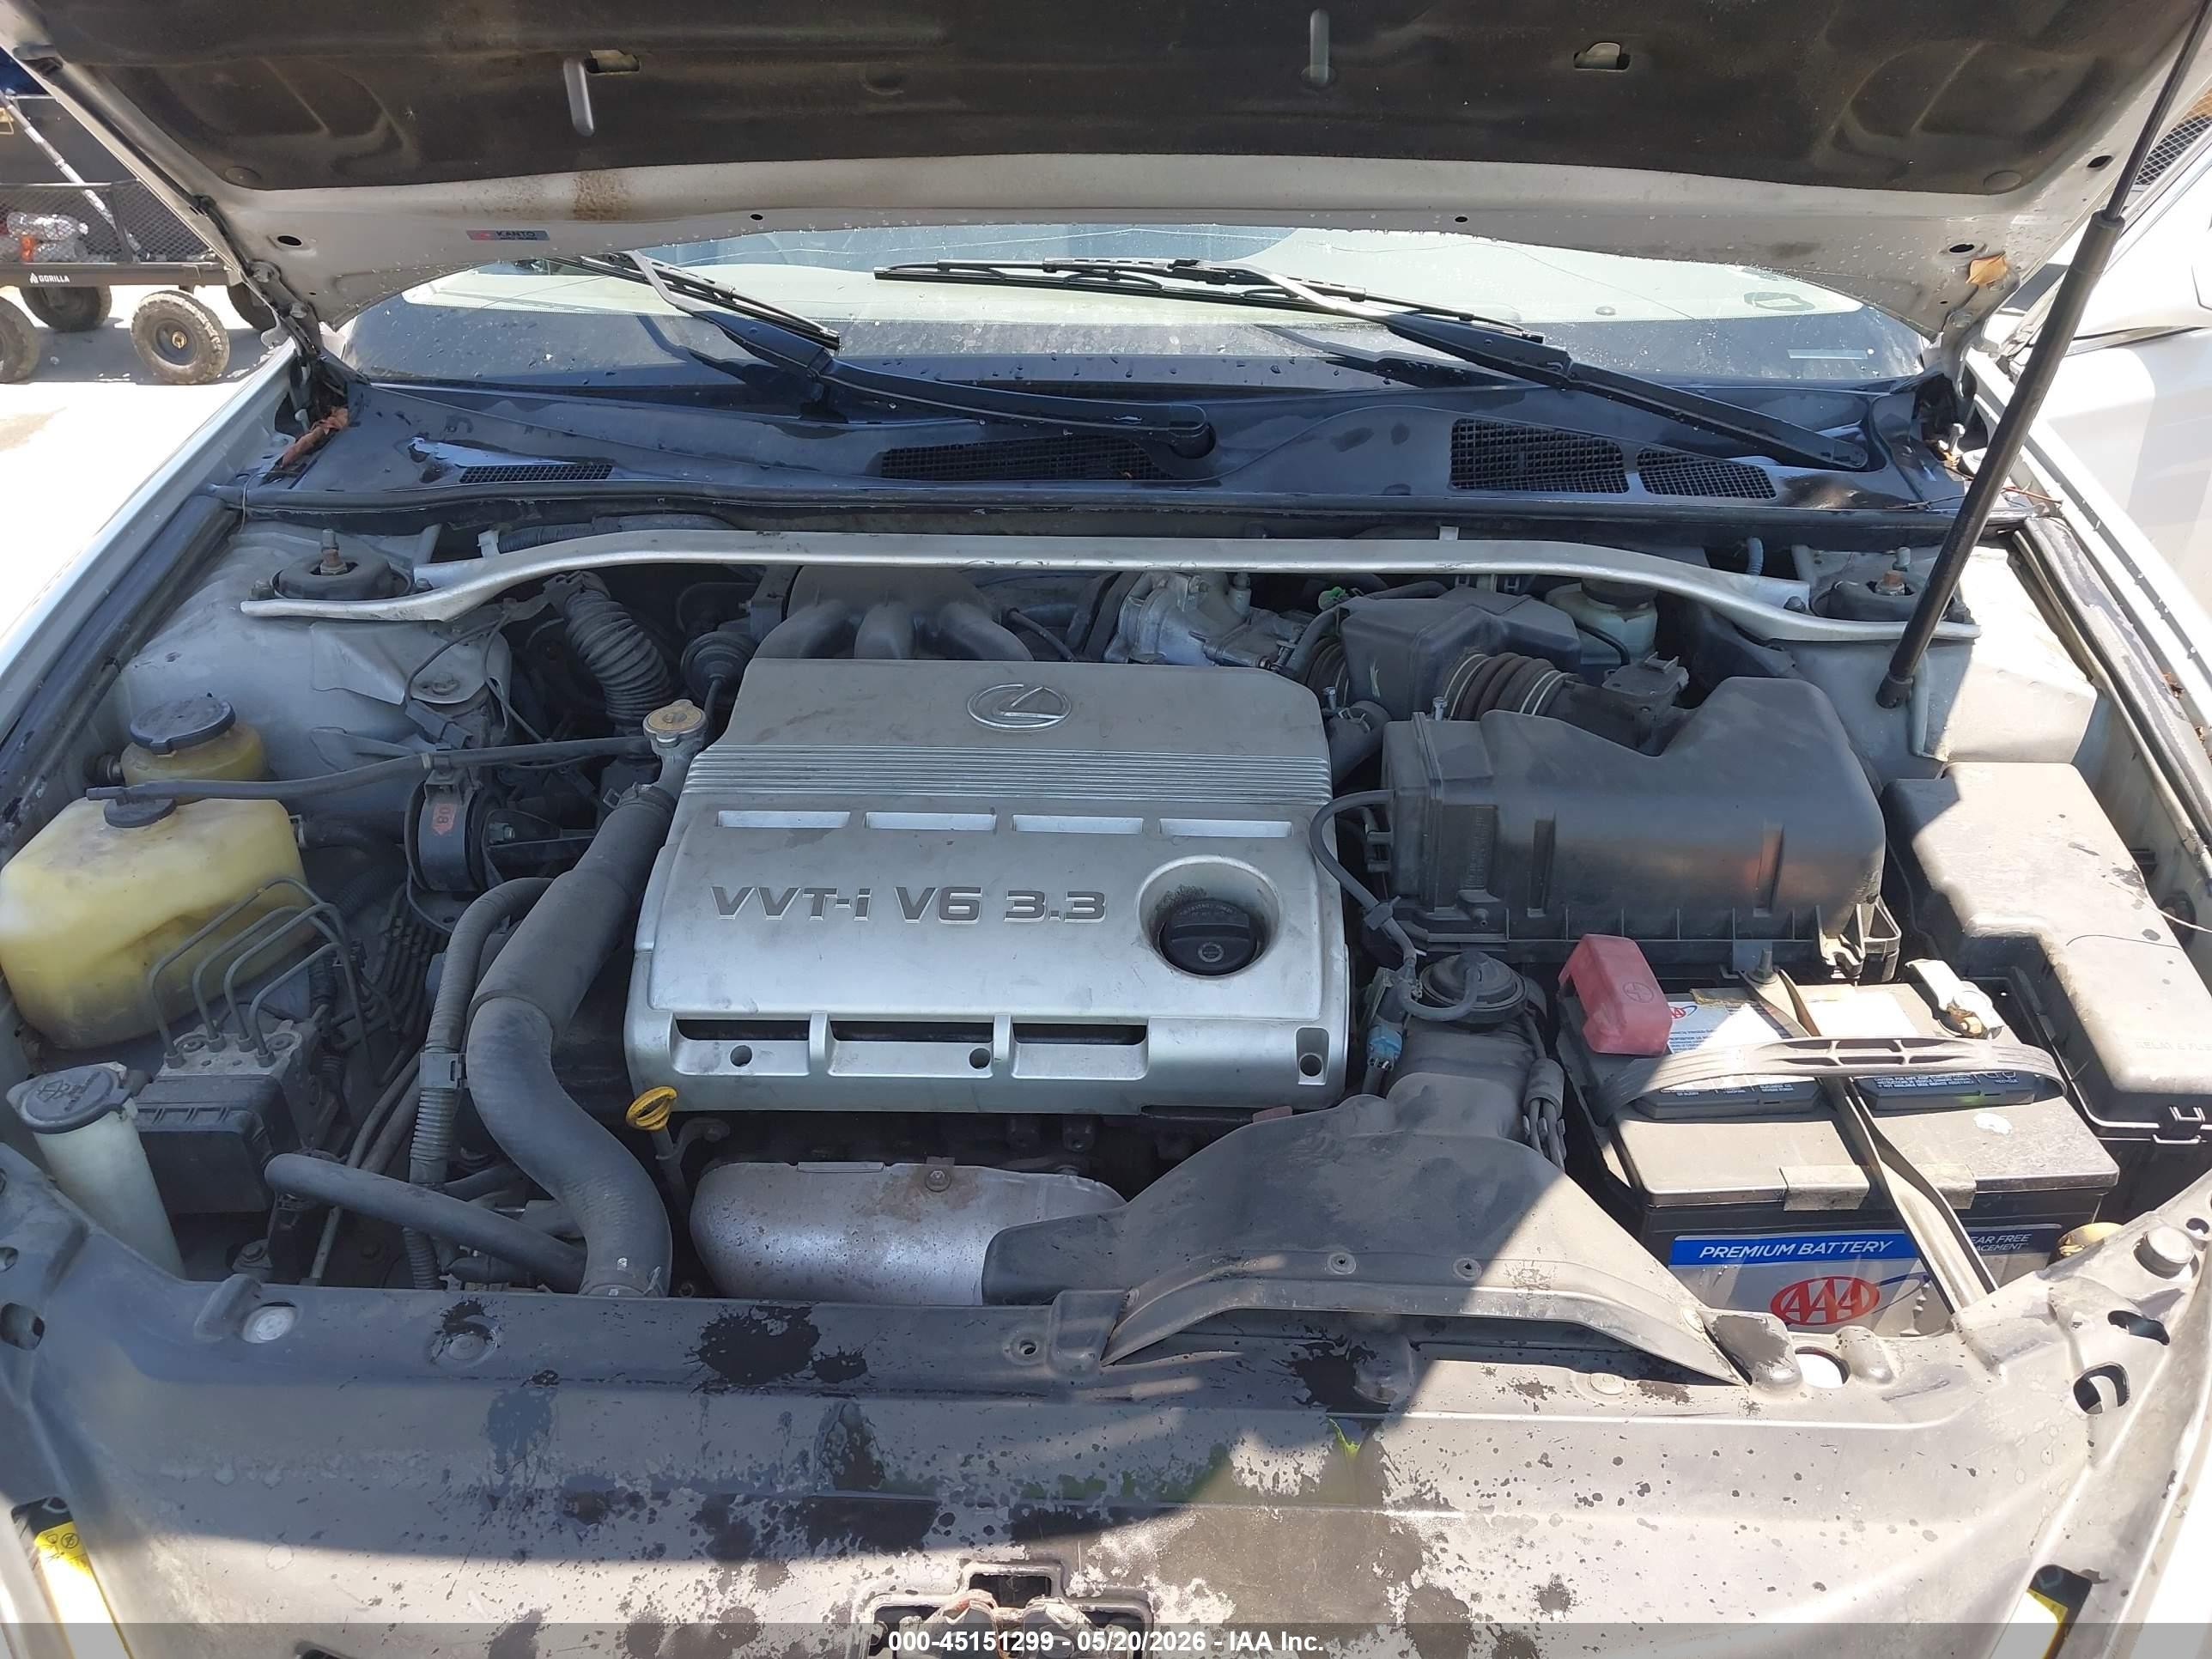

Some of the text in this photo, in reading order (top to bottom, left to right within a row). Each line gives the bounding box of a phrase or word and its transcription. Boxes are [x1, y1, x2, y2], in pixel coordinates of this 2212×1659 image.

[709, 885, 1106, 924] VVT-i V6 3.3
[1971, 1234, 2033, 1244] EAR FREE
[1975, 1243, 2026, 1251] ACEMENT
[1698, 1240, 1893, 1259] PREMIUM BATTERY
[1778, 1277, 1875, 1325] AAA
